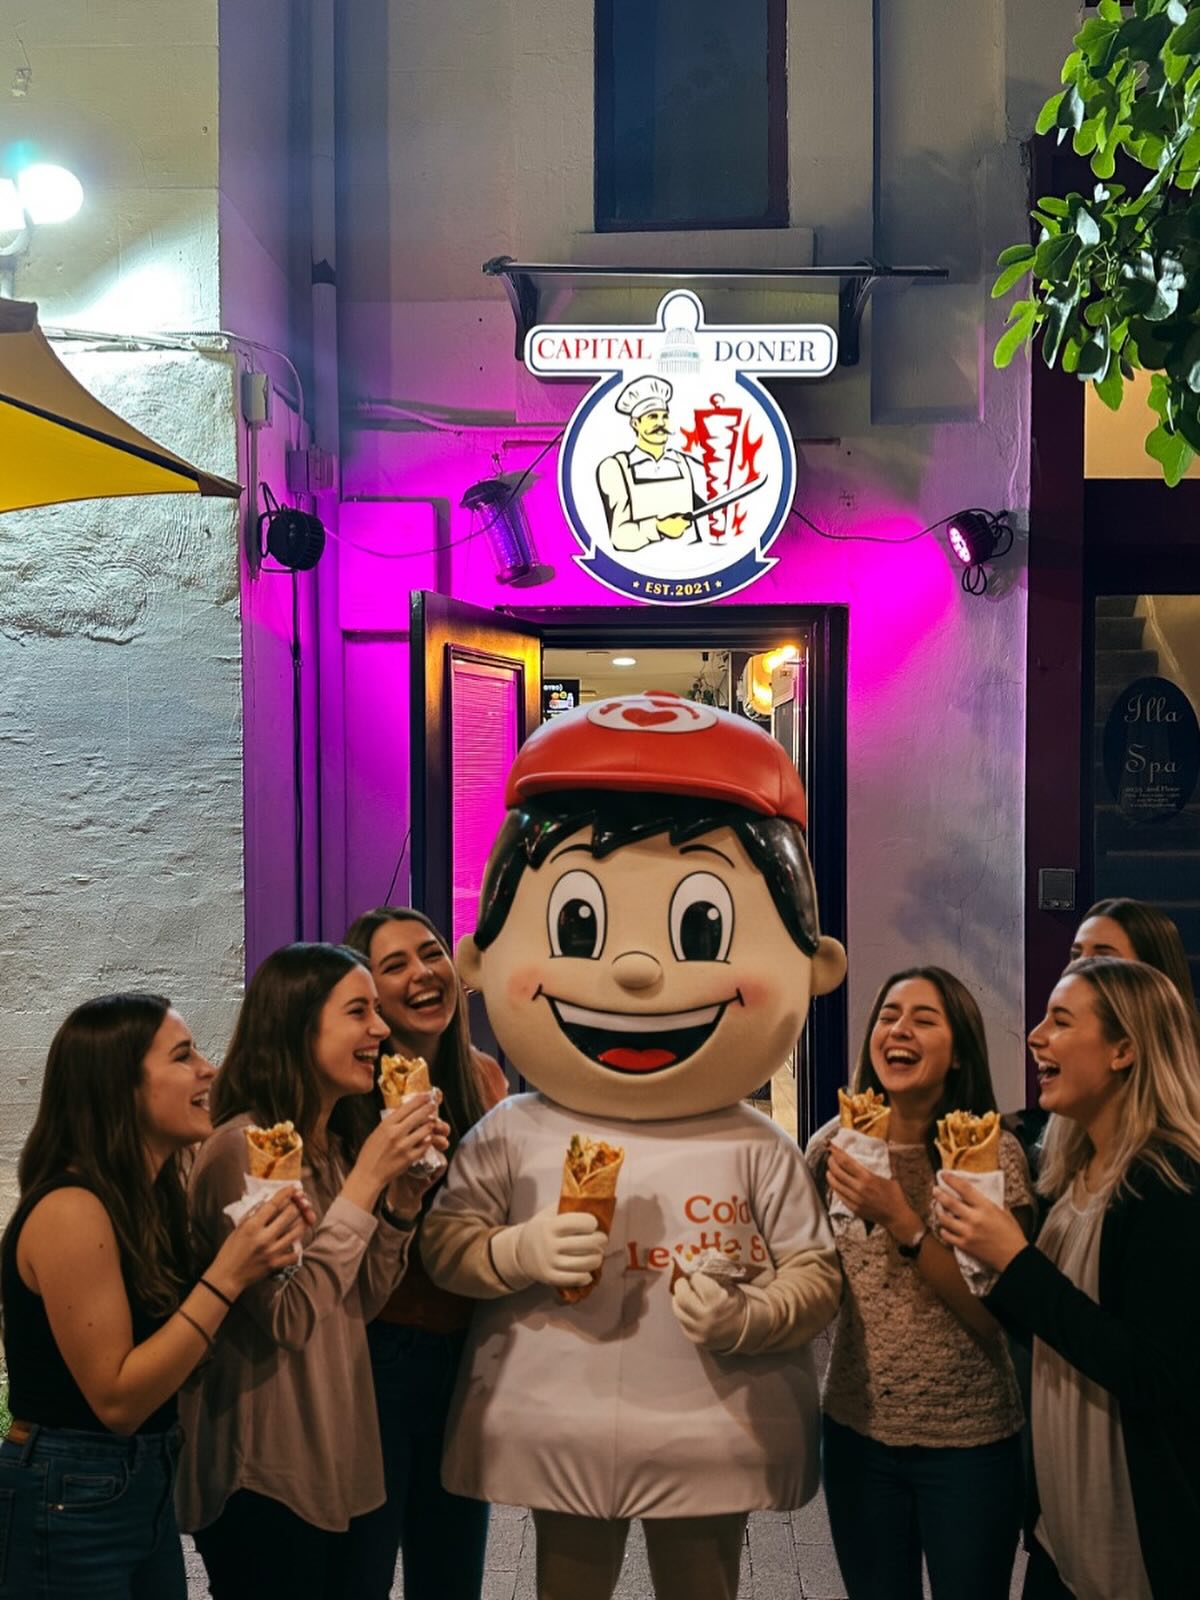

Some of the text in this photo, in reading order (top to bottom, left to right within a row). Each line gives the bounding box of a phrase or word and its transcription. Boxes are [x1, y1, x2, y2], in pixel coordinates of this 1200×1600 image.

[537, 337, 816, 362] CAPITAL DONER
[645, 580, 711, 596] EST.2021
[1125, 743, 1178, 783] Spa
